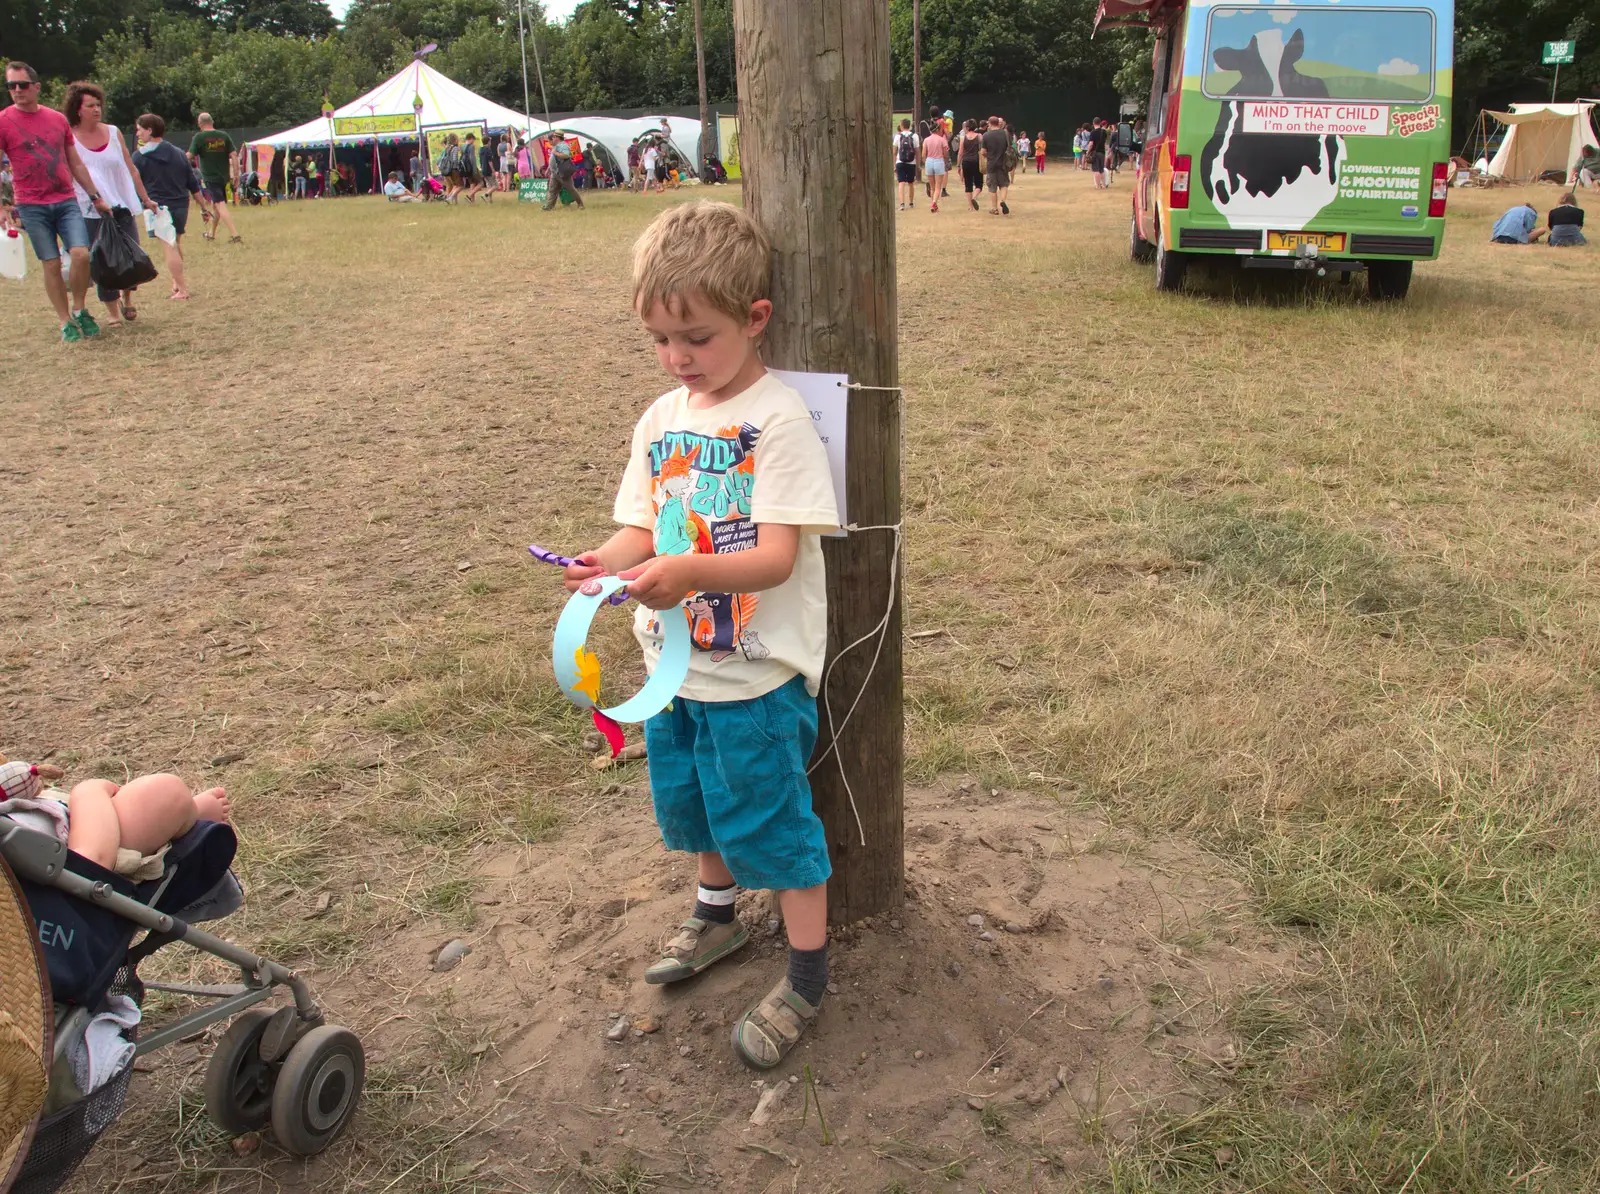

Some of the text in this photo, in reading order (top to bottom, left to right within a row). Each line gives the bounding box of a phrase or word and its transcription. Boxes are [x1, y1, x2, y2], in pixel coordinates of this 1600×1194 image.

[1252, 105, 1380, 121] MIND THAT CHILD
[1391, 105, 1439, 126] Special
[1264, 120, 1367, 133] I'm on the moove
[1399, 118, 1435, 137] Guest
[1341, 164, 1420, 175] LOVINGLY MADE
[520, 181, 530, 190] NO
[1340, 175, 1420, 189] & MOOVING
[1339, 188, 1419, 200] TO FAIRTRADE
[690, 472, 755, 518] 2013
[713, 520, 755, 535] MORE THAN
[714, 529, 756, 545] JUST A MUSIC
[718, 538, 756, 554] FESTIVAL
